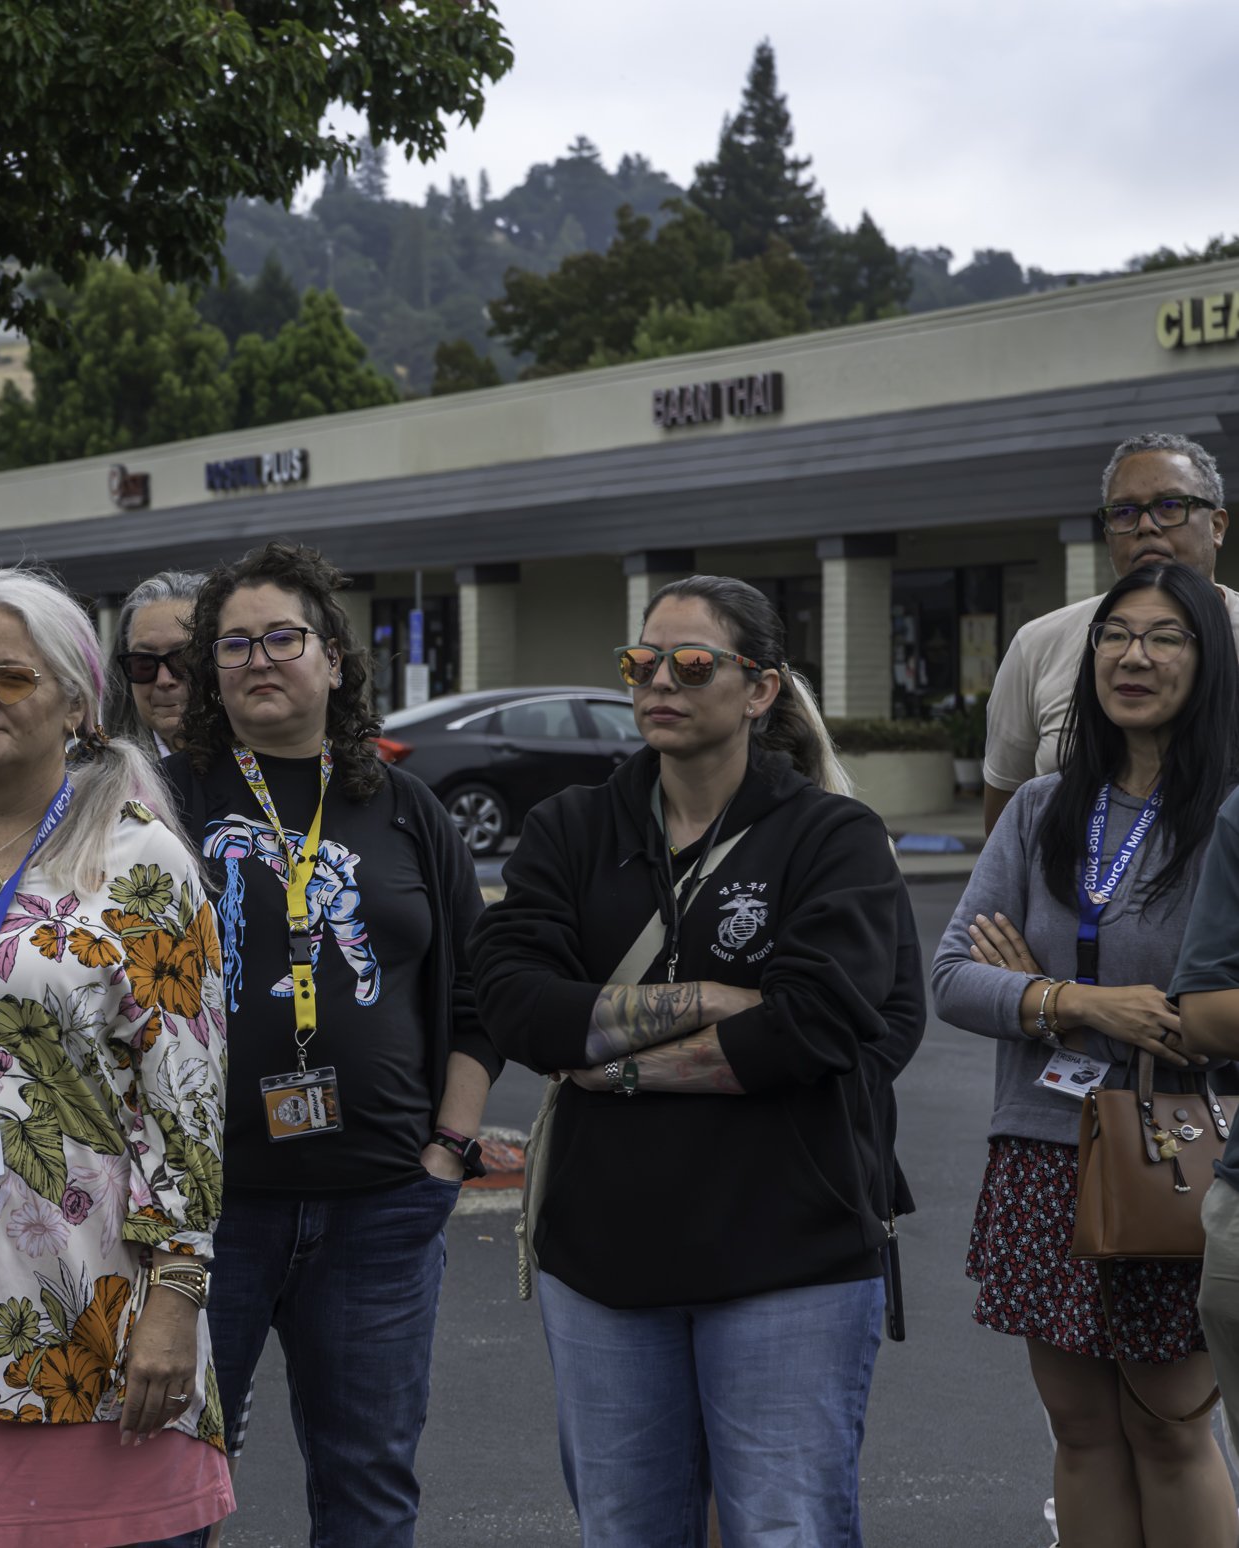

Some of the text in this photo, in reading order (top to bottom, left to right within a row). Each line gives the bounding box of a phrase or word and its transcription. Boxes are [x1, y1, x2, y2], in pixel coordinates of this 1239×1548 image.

[652, 370, 778, 427] BAAN THAI
[261, 449, 306, 484] PLUS
[1084, 784, 1108, 890] NIS Since 2003
[1100, 809, 1155, 896] NorCal MINIS
[710, 939, 774, 963] CAMP MUJUK
